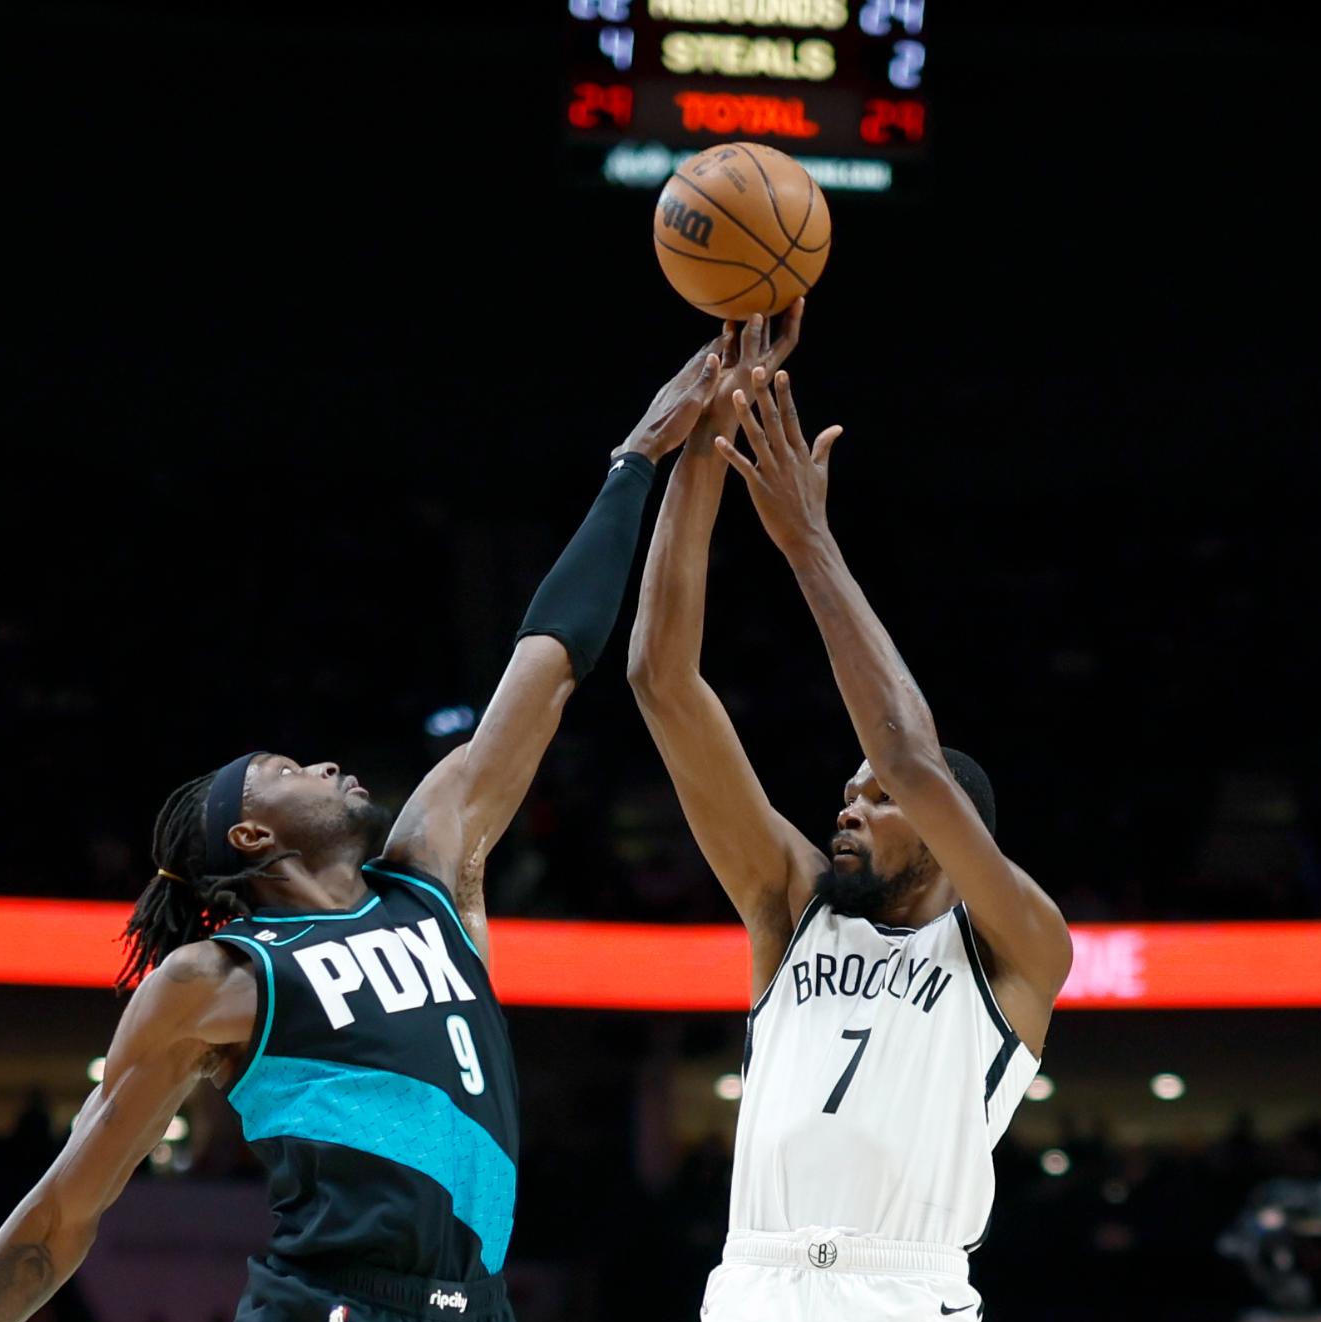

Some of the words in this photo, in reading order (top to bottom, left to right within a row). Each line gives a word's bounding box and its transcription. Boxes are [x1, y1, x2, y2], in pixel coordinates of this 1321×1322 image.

[662, 31, 836, 81] STEALS
[674, 91, 820, 138] TOTAL
[292, 917, 477, 1031] PDX
[792, 948, 953, 1014] BROOLYN
[446, 1014, 485, 1096] 9
[822, 1027, 872, 1114] 7
[429, 1289, 468, 1313] ripcity
